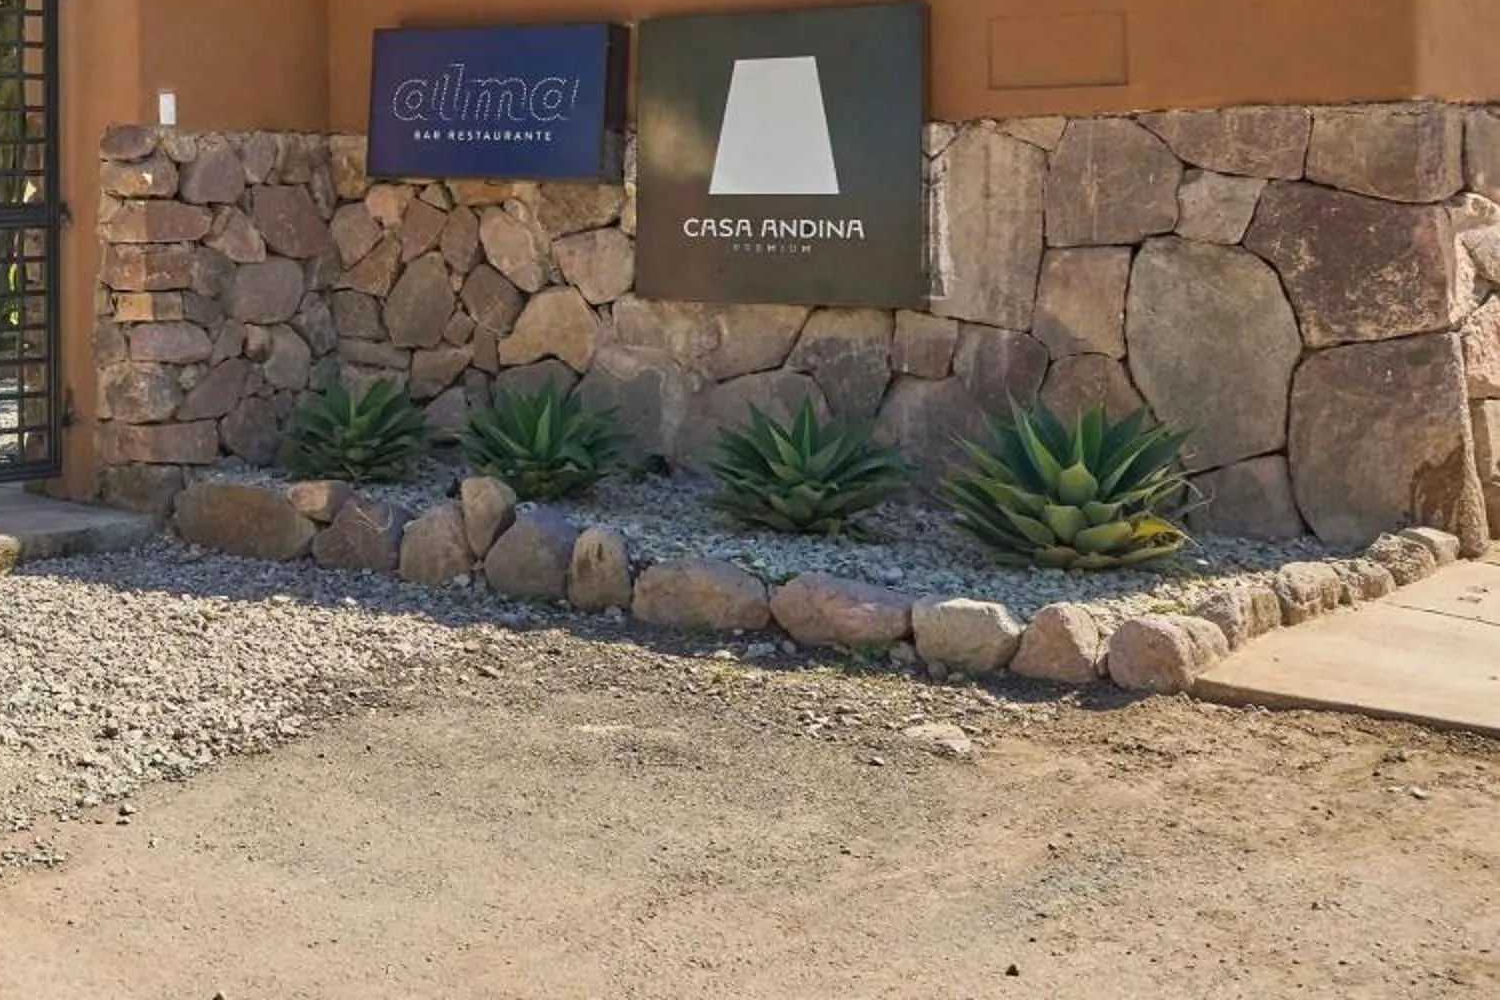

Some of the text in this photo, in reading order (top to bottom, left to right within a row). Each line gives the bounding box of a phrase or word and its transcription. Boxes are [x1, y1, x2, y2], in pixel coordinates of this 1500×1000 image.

[393, 62, 580, 121] alma
[413, 130, 552, 141] BAR RESTAURANTE
[683, 218, 865, 239] CASA ANDINA
